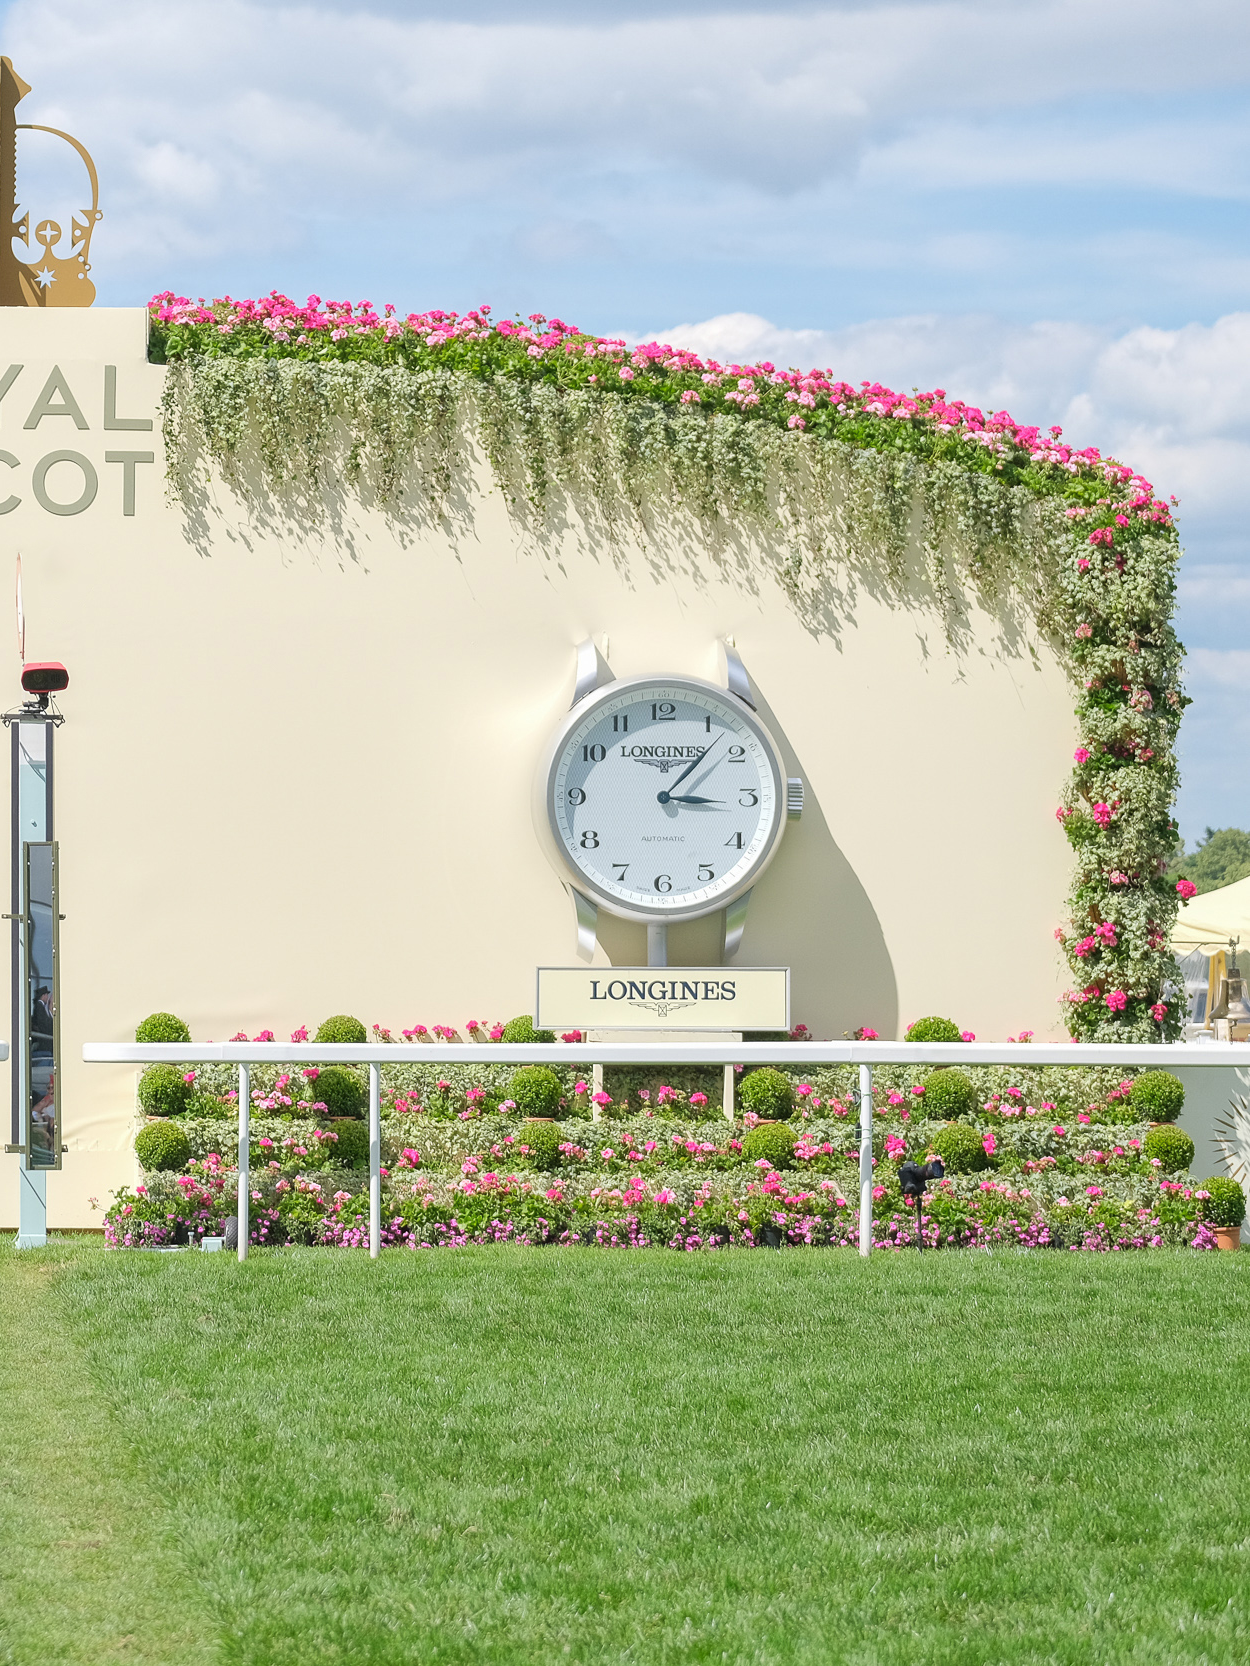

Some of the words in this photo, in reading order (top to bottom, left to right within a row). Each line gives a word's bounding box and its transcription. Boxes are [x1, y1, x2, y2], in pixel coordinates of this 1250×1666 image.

[650, 702, 676, 721] 12
[611, 714, 629, 732] 11
[704, 715, 712, 733] 1
[582, 743, 607, 763] 10
[621, 745, 706, 759] LONGINES
[728, 745, 746, 763] 2
[567, 787, 587, 806] 9
[738, 788, 759, 807] 3
[579, 830, 600, 849] 8
[723, 831, 746, 850] 4
[612, 863, 630, 881] 7
[697, 863, 715, 882] 5
[653, 874, 673, 893] 6
[589, 980, 737, 1001] LONGINES
